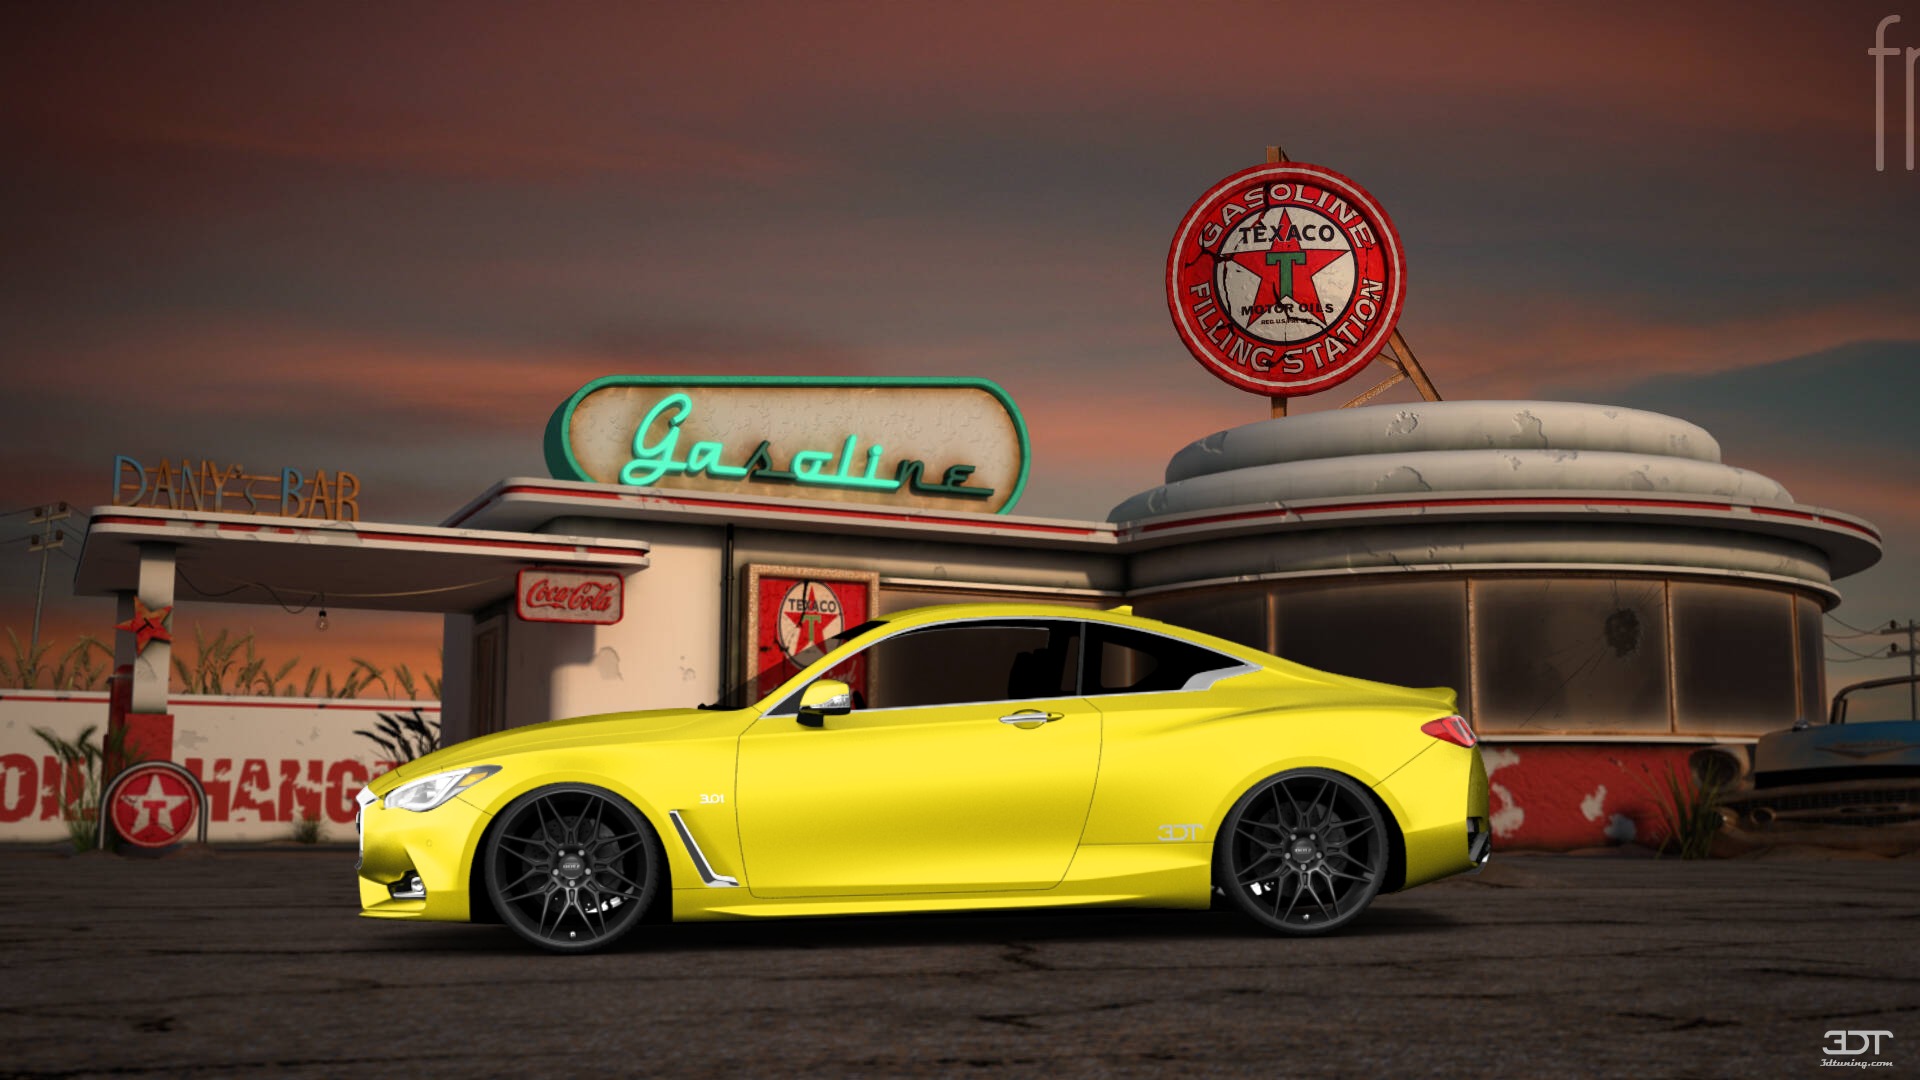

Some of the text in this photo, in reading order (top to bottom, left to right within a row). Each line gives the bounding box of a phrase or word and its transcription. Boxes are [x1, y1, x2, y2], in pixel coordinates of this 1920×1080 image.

[1198, 183, 1376, 249] GASOLINE
[1238, 223, 1335, 244] TEXACO
[1190, 277, 1384, 374] FILLING STATION
[1241, 303, 1334, 316] MOTOR OILS
[619, 392, 995, 500] Gasoline
[280, 466, 361, 522] BAR
[787, 598, 837, 613] TEXACO
[1157, 824, 1204, 841] 3DT
